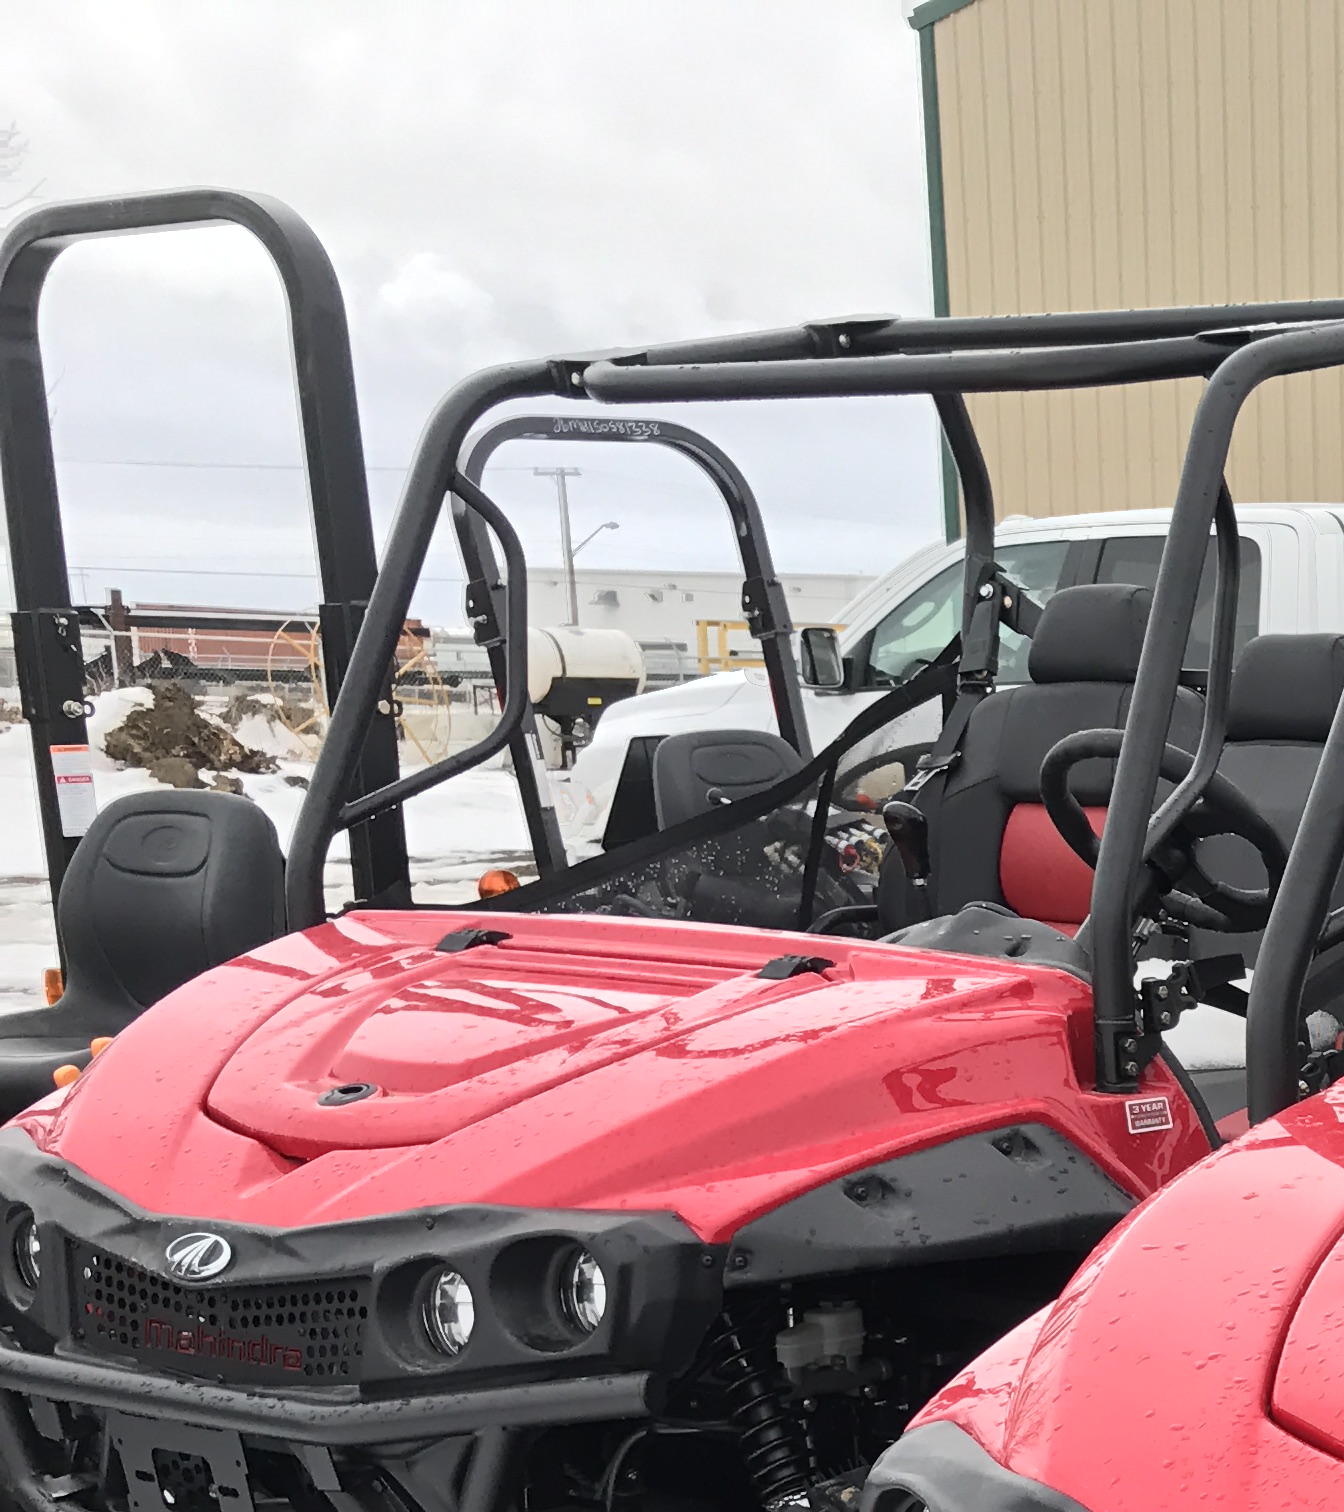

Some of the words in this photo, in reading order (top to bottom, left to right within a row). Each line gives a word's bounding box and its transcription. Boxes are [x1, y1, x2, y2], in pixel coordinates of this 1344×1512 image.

[1132, 1105, 1140, 1114] 3
[1141, 1102, 1164, 1112] YEAR
[144, 1318, 303, 1371] Mahindra
